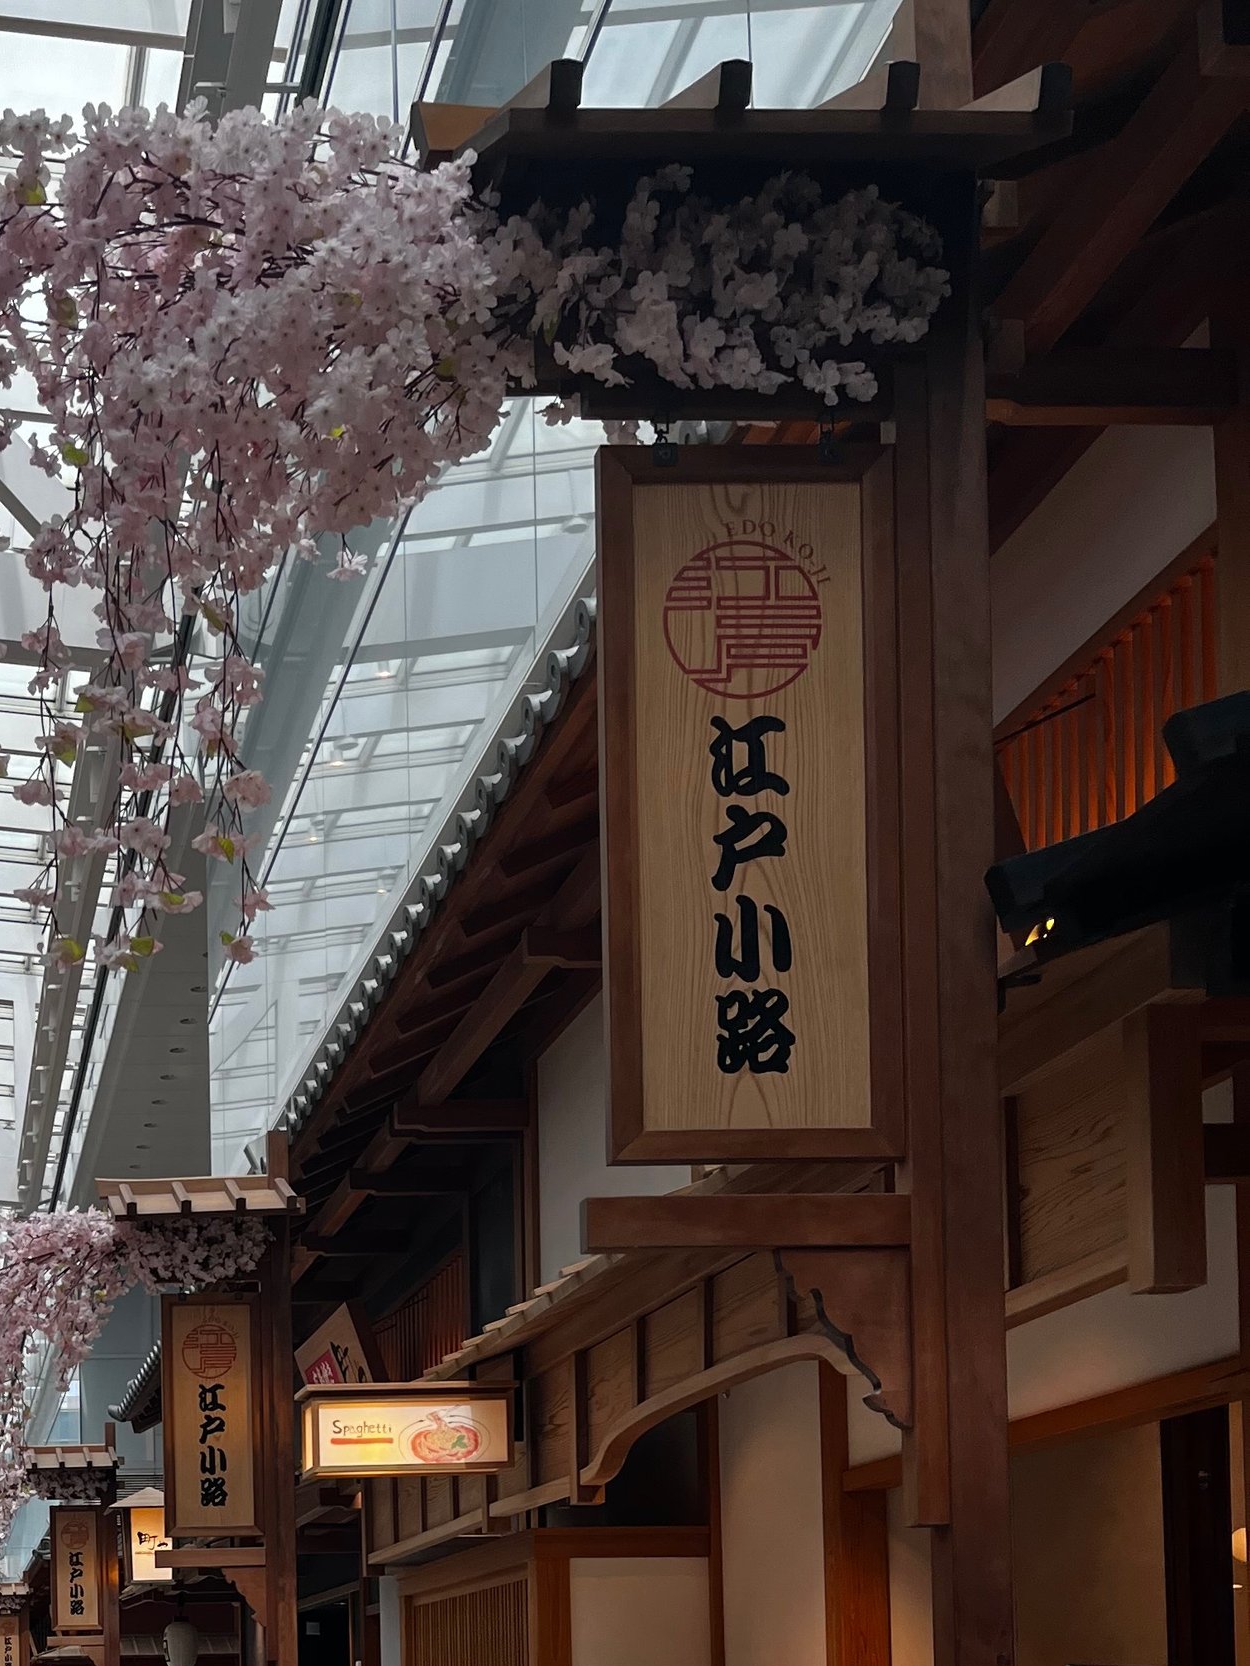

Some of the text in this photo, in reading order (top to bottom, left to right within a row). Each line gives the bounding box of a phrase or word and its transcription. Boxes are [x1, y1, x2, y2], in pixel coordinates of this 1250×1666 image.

[724, 519, 776, 538] EDO
[708, 714, 797, 1075] 江戸小路
[198, 1383, 228, 1507] 江戸小路
[332, 1419, 393, 1438] Spaghetti
[68, 1551, 85, 1616] 江戸小路
